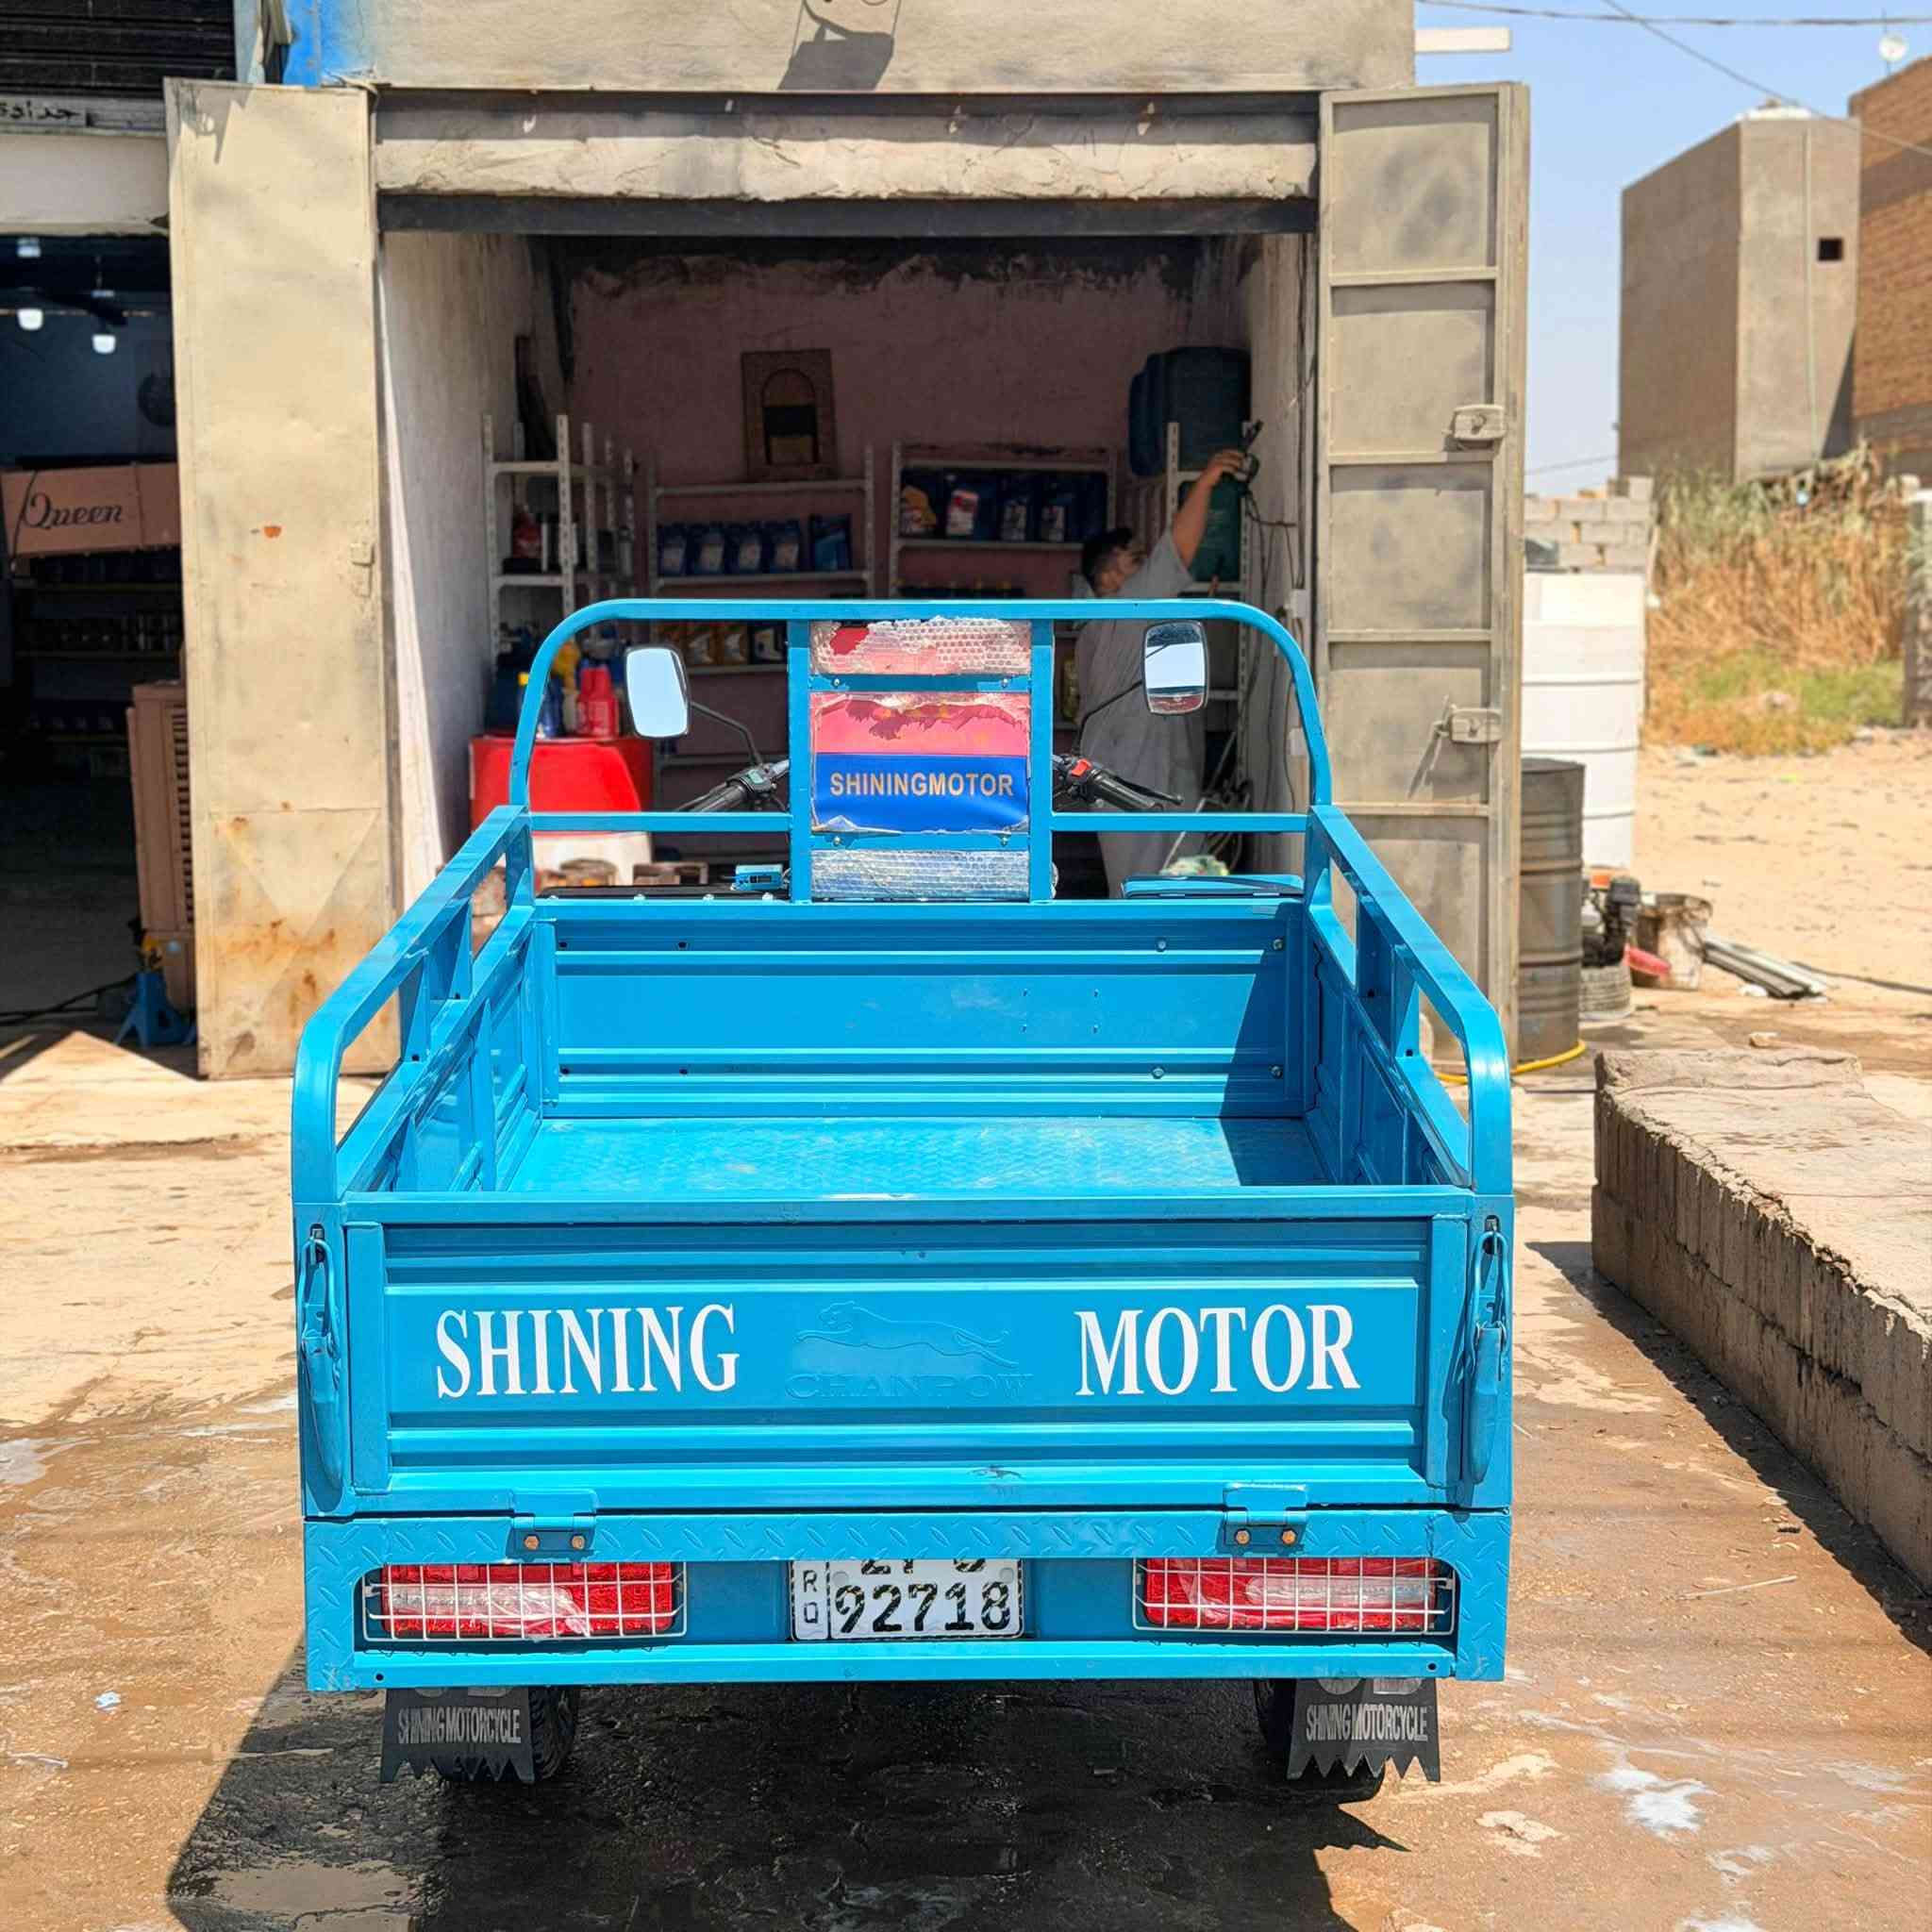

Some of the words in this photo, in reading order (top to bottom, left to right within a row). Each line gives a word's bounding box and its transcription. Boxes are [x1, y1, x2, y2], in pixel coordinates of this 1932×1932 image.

[24, 491, 123, 530] Queen
[829, 772, 1014, 797] SHININGMOTOR
[436, 1303, 740, 1398] SHINING
[1074, 1304, 1361, 1395] MOTOR
[835, 1581, 1011, 1634] 92718
